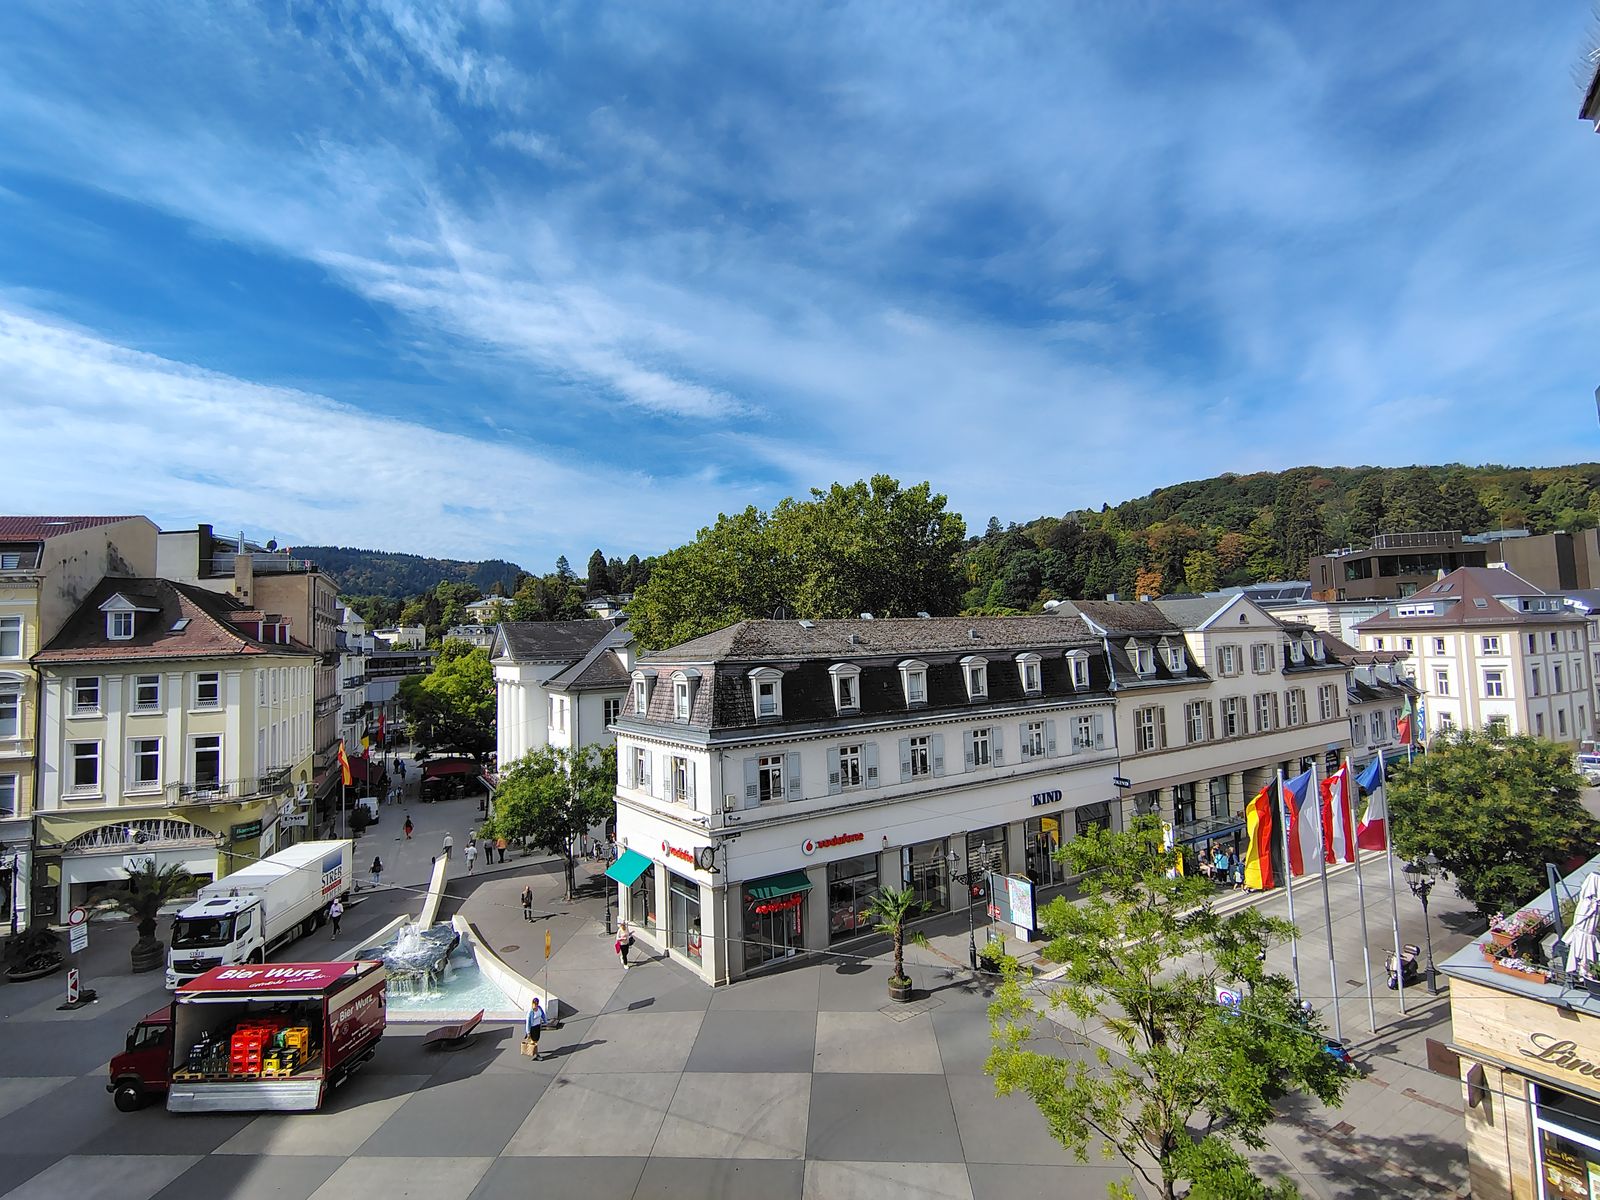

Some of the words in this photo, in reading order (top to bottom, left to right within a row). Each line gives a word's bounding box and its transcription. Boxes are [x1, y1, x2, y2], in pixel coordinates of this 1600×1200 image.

[1032, 790, 1062, 807] KIND
[817, 832, 864, 848] vodafone
[216, 968, 262, 980] Bier
[264, 967, 321, 979] Wurz
[339, 1005, 355, 1022] Bier
[355, 993, 373, 1011] Wurz
